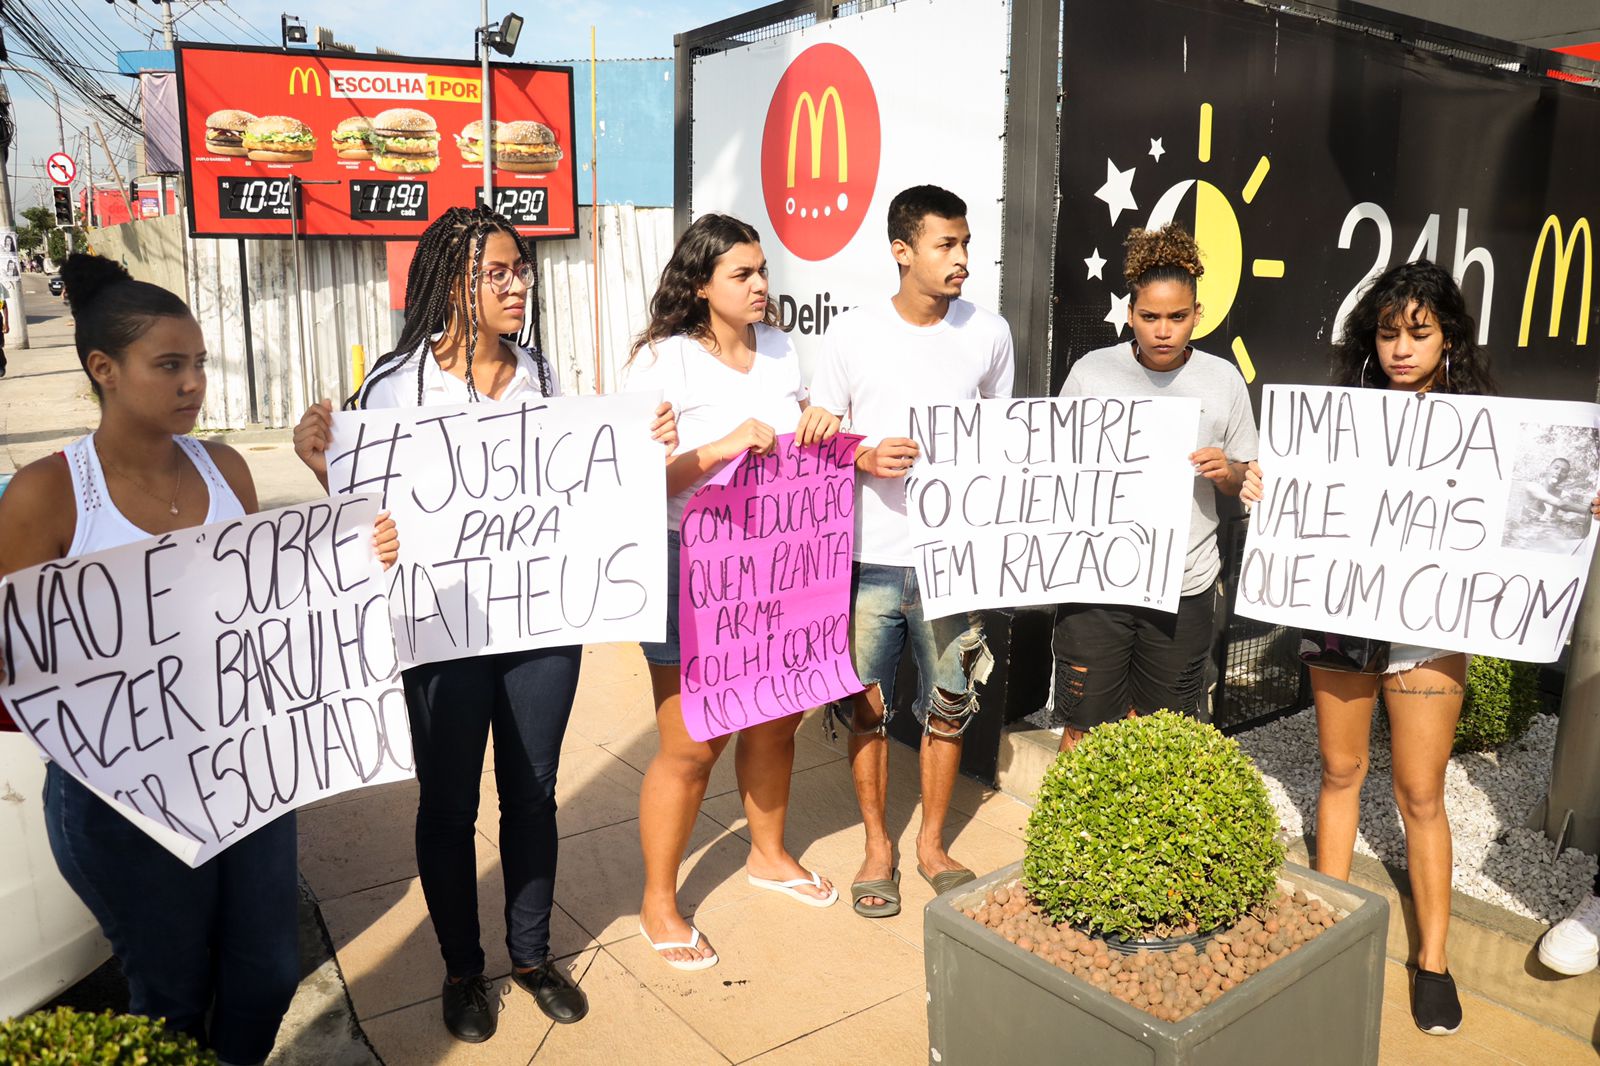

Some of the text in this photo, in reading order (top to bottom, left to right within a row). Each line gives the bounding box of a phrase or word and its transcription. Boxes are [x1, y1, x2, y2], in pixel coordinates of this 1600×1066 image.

[334, 76, 478, 98] ESCOLHA 1 POR
[786, 440, 809, 480] SE
[816, 437, 861, 474] FAZ
[909, 398, 1153, 466] NEM SEMPRE
[1268, 389, 1502, 480] UMA VIDA
[681, 474, 854, 548] COM EDUCAÇÃO
[962, 467, 1143, 527] CLIENTE
[1257, 476, 1486, 552] VALE MAIS
[454, 505, 560, 558] PARA
[689, 531, 849, 609] QUEM PLANTA
[913, 539, 978, 599] TEM
[1240, 547, 1580, 651] QUE UM CUPOM
[4, 560, 123, 685] NÃO
[144, 534, 181, 646] É
[716, 600, 784, 645] ARMA
[783, 613, 849, 668] CORPO
[11, 655, 206, 778] FAZER
[704, 687, 747, 736] NO
[188, 687, 415, 843] ESCUTADO
